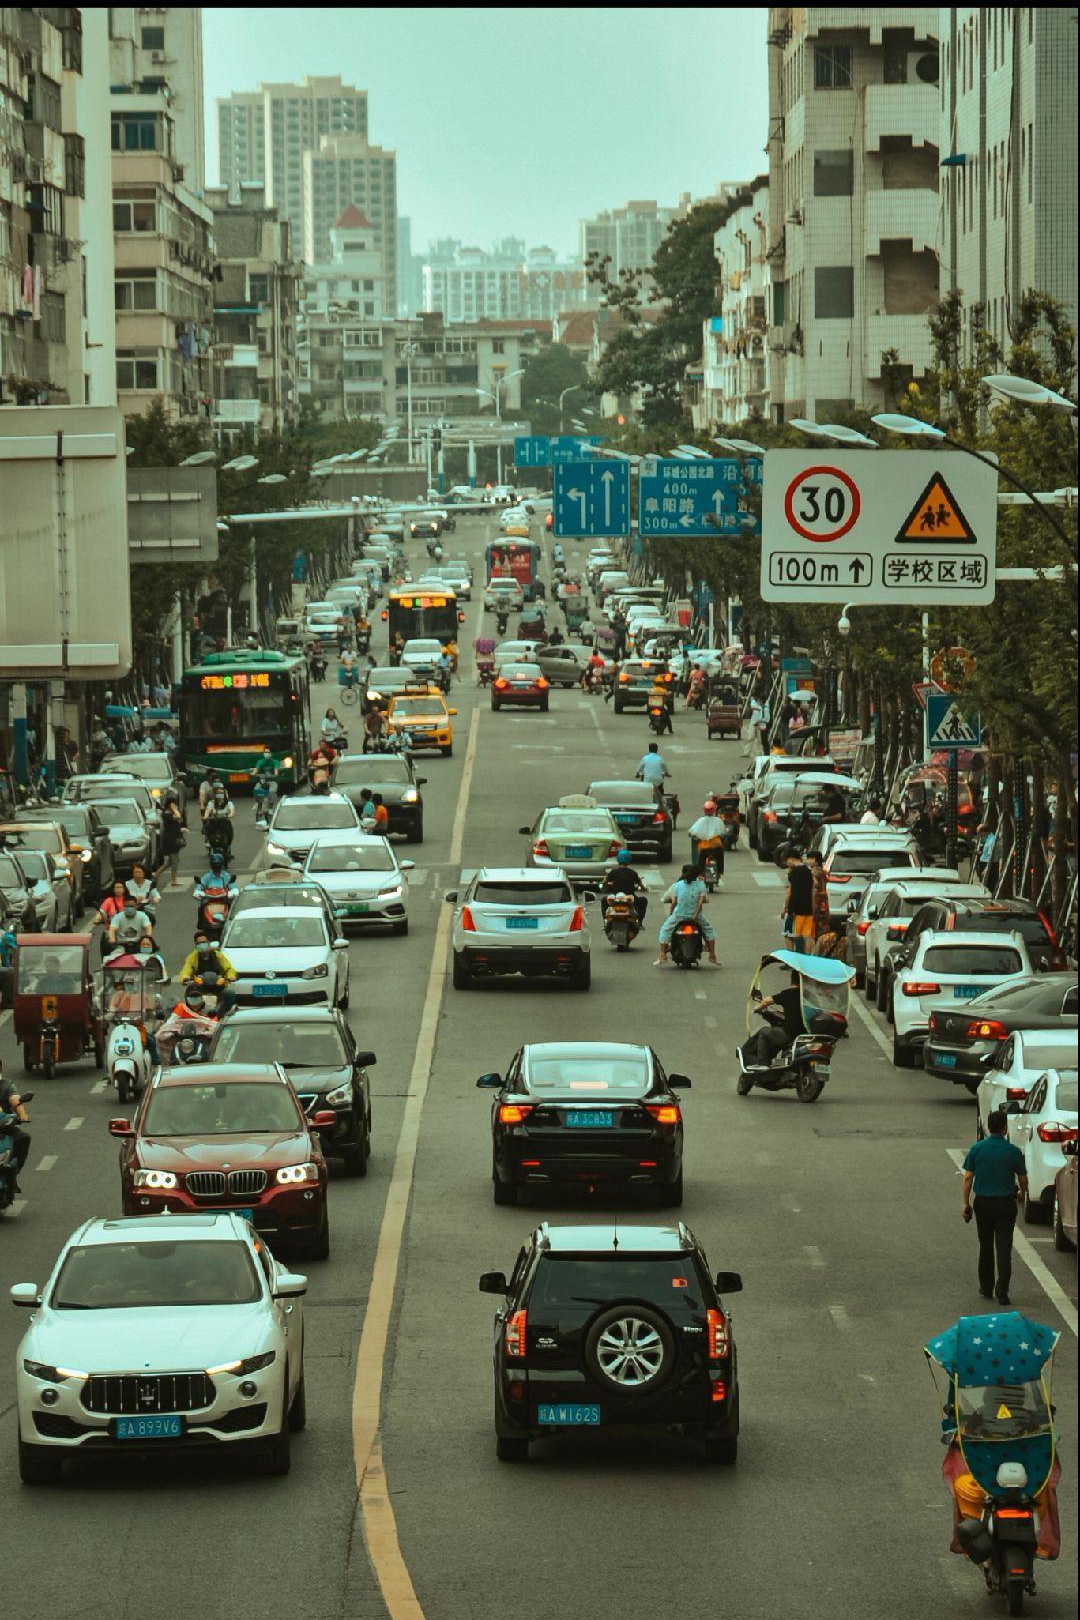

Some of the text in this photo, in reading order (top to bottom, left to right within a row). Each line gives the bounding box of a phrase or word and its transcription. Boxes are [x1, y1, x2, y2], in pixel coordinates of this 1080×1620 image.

[645, 497, 694, 513] 阜阳路
[799, 487, 845, 523] 30
[644, 516, 678, 529] 300m
[777, 557, 839, 582] 100m
[887, 558, 982, 583] 学校区域
